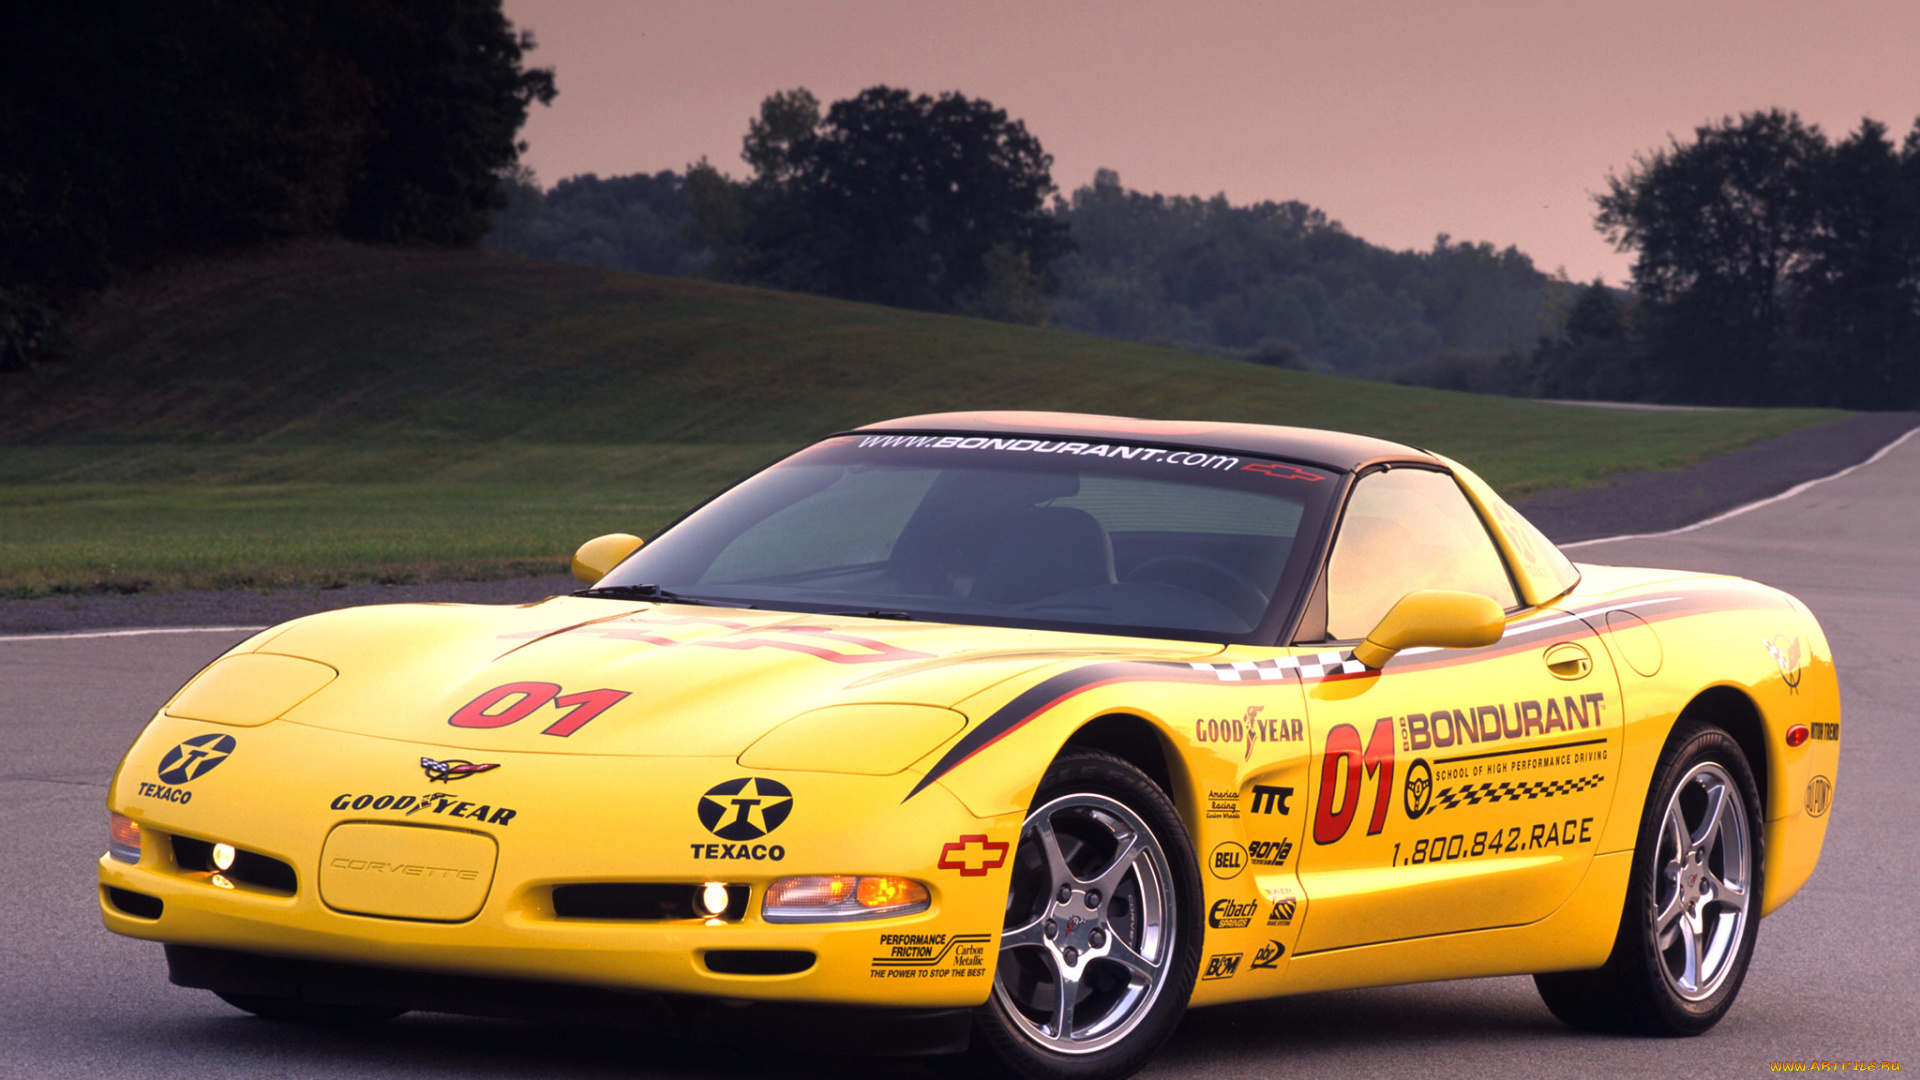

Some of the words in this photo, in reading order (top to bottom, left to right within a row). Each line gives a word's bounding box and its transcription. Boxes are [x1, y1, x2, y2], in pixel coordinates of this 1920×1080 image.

[858, 435, 1239, 471] www.BONDURANT.com
[448, 681, 631, 738] 01
[1407, 692, 1604, 751] BONDURANT
[1399, 716, 1410, 752] BOB
[1436, 766, 1469, 781] SCHOOL
[1473, 764, 1483, 777] OF
[1487, 761, 1507, 774] HIGH
[1511, 754, 1571, 771] PERFORMANCE
[1574, 749, 1608, 763] DRIVING
[1313, 716, 1395, 845] 01
[138, 782, 192, 805] TEXACO
[1208, 789, 1240, 798] America
[1211, 801, 1236, 813] Racing
[690, 843, 785, 862] TEXACO
[1392, 817, 1594, 867] 1.800.842.RACE
[330, 857, 479, 881] CORVETTE
[1214, 852, 1241, 868] BELL
[1208, 898, 1258, 929] Eibach
[880, 934, 946, 946] PERFORMANCE
[891, 946, 932, 957] FRICTION
[955, 944, 983, 956] Carbon
[953, 955, 984, 967] Metallic
[870, 969, 886, 978] THE
[887, 969, 916, 978] POWER
[918, 969, 928, 978] TO
[930, 969, 950, 978] STOP
[951, 968, 966, 977] THE
[967, 968, 986, 977] BEST
